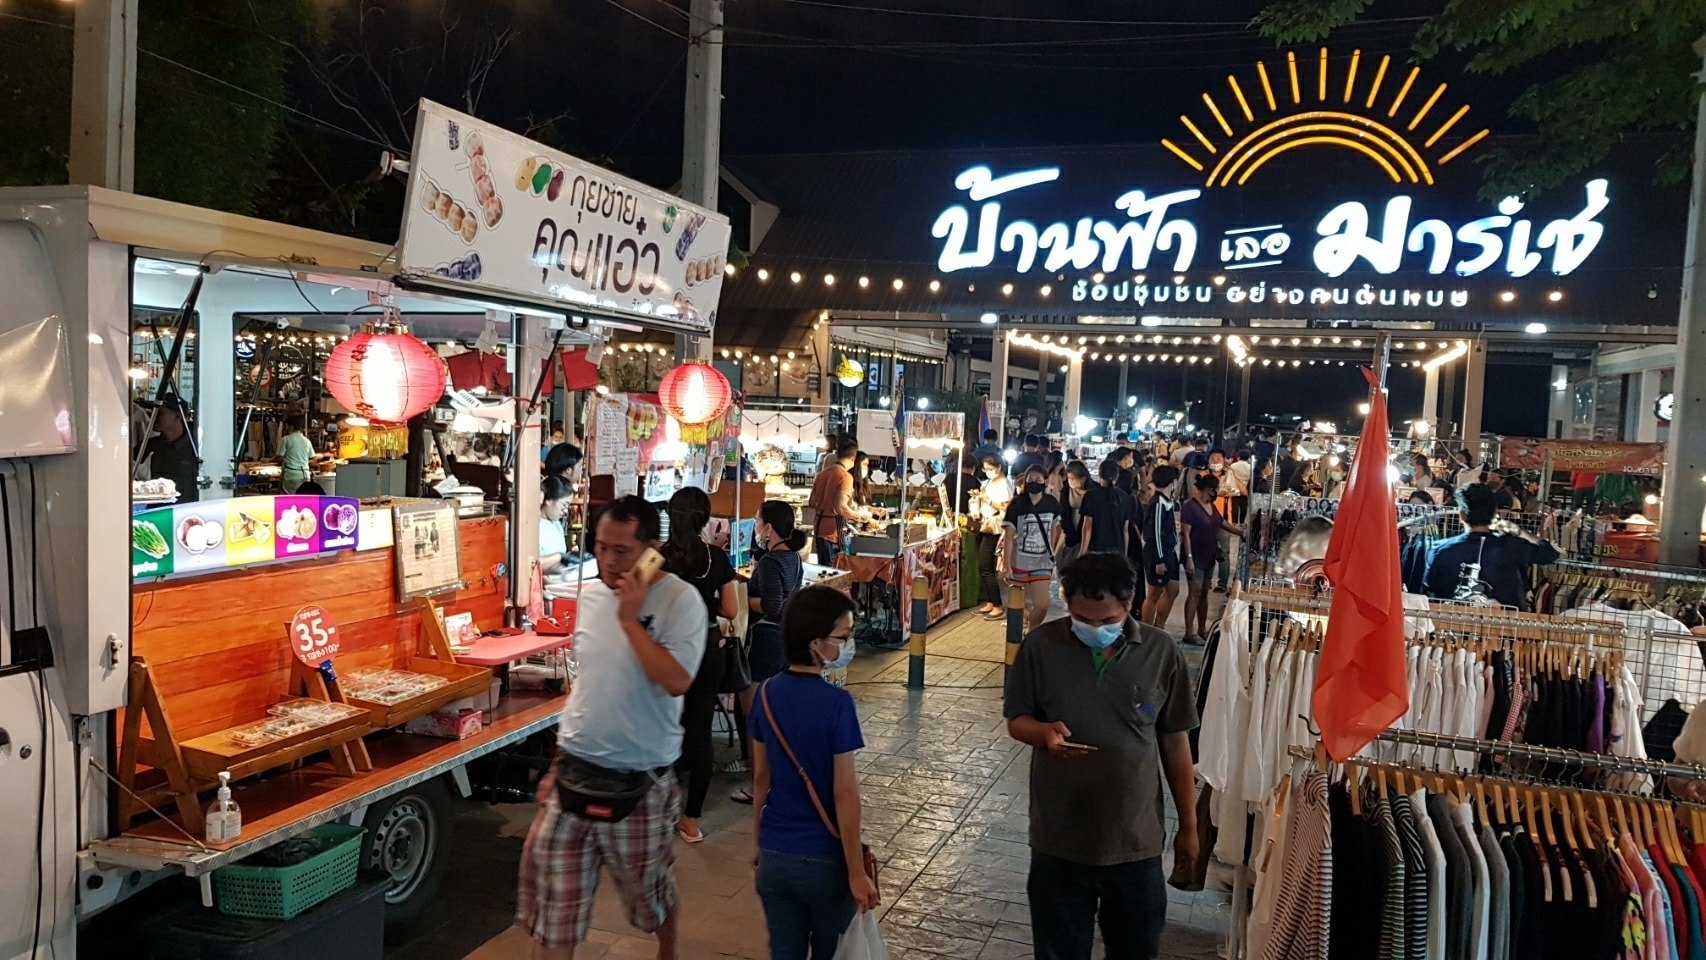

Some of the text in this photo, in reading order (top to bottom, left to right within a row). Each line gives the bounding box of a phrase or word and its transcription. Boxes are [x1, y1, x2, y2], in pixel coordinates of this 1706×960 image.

[570, 175, 638, 225] กุยช่าย
[931, 165, 1610, 278] บ้านฟ้า เลอ มาร์เช่
[532, 216, 660, 296] คุณแอ๋ว
[1072, 279, 1212, 307] ช้อปชุมชน
[295, 617, 336, 652] 35-
[300, 654, 307, 663] 3
